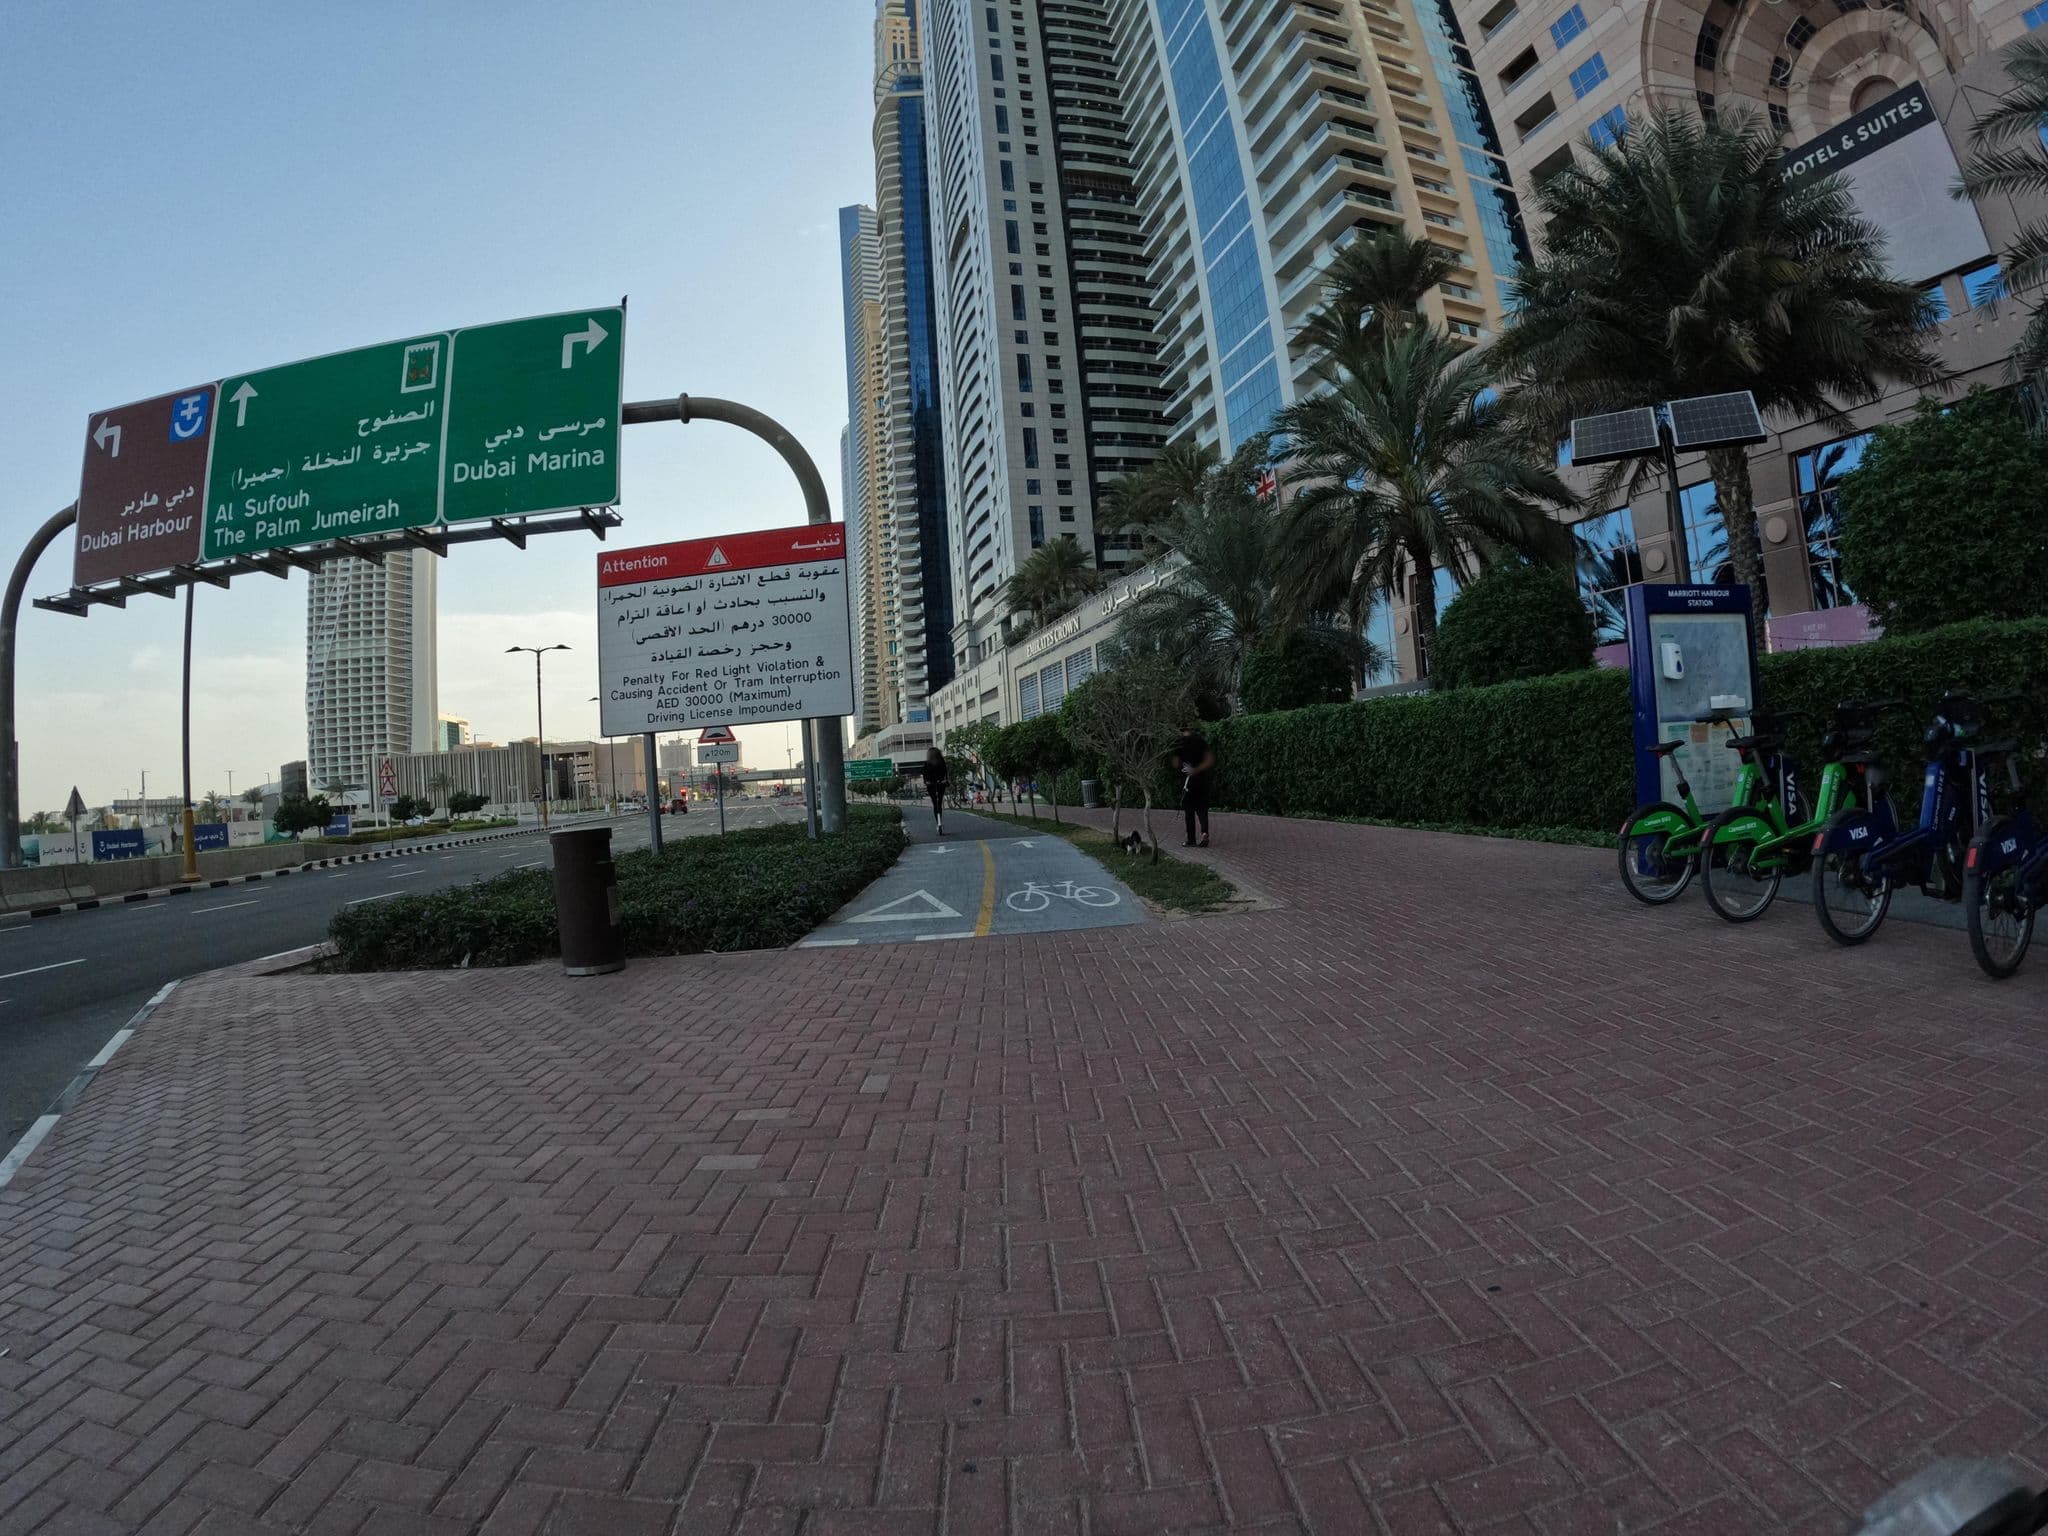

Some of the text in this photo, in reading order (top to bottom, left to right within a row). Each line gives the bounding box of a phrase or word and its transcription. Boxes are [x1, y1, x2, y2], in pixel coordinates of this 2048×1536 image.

[1841, 135, 1856, 150] &
[1857, 97, 1923, 142] SUITES
[358, 400, 435, 436] الصفوح
[485, 417, 606, 453] مرسى دبي
[231, 440, 431, 490] جزيرة النخلة (جميرا)
[453, 448, 605, 483] Dubai Marina
[120, 485, 195, 516] دبي هاربر
[215, 489, 310, 524] Al Sufouh
[80, 515, 193, 553] Dubai Harbour
[214, 499, 399, 547] The Palm Jumeirah
[602, 555, 668, 574] Attention
[798, 565, 840, 580] عقوبة
[757, 568, 791, 587] قطع
[714, 597, 761, 609] بحادث
[768, 588, 826, 605] والتسبب
[618, 607, 650, 627] الترام
[731, 619, 765, 635] درهم
[771, 612, 812, 626] 30000
[651, 641, 792, 663] وحجز رخصة القيادة
[623, 655, 825, 687] Penalty For Red Light Violation &
[611, 669, 841, 701] Causing Accident Or Tram Interruption
[656, 685, 792, 709] AED 30000 (Maximum)
[647, 700, 802, 724] Driving License Impounded
[1786, 772, 1797, 816] VISA
[1850, 826, 1868, 840] VISA
[2001, 838, 2017, 855] VISA
